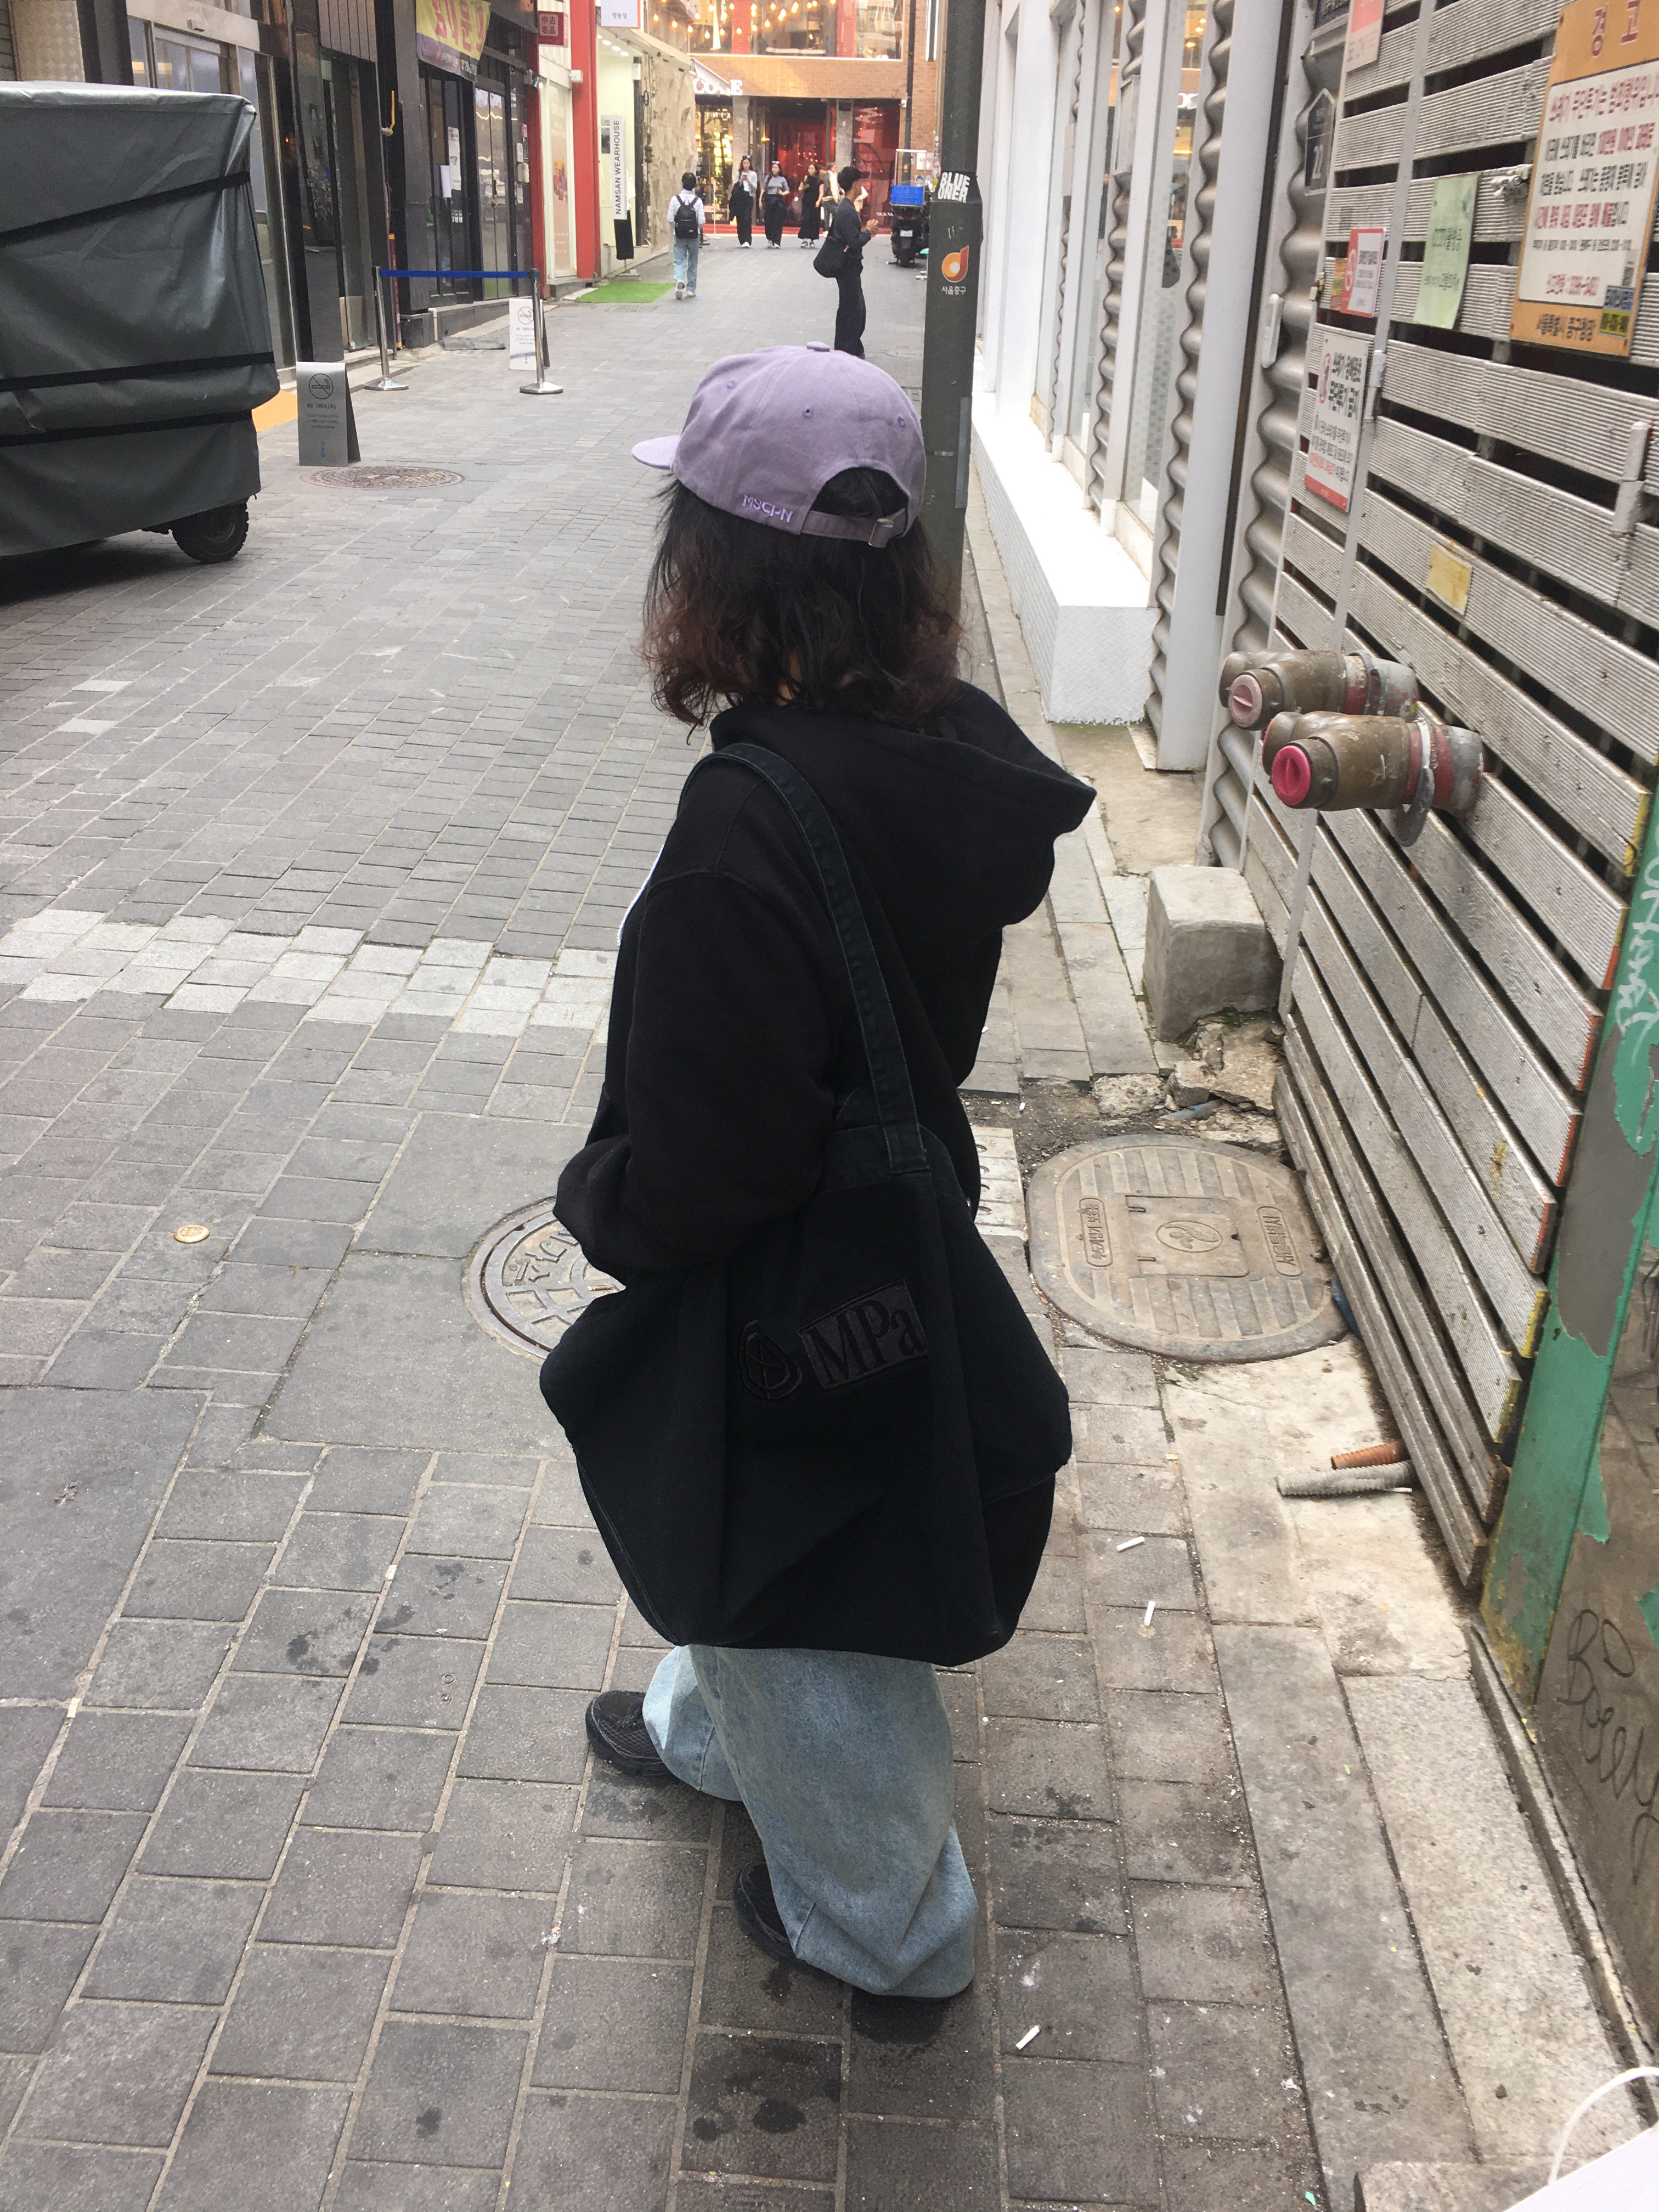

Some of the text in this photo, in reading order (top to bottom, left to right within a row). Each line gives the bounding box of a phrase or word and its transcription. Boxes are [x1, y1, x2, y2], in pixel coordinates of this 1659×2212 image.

[541, 15, 556, 25] 中古
[1549, 93, 1570, 123] 쓰레기
[940, 172, 970, 189] BLUE
[938, 184, 968, 203] ONER
[941, 286, 966, 295] 서울중구
[742, 494, 794, 522] MSCPN
[805, 1299, 926, 1384] MPa
